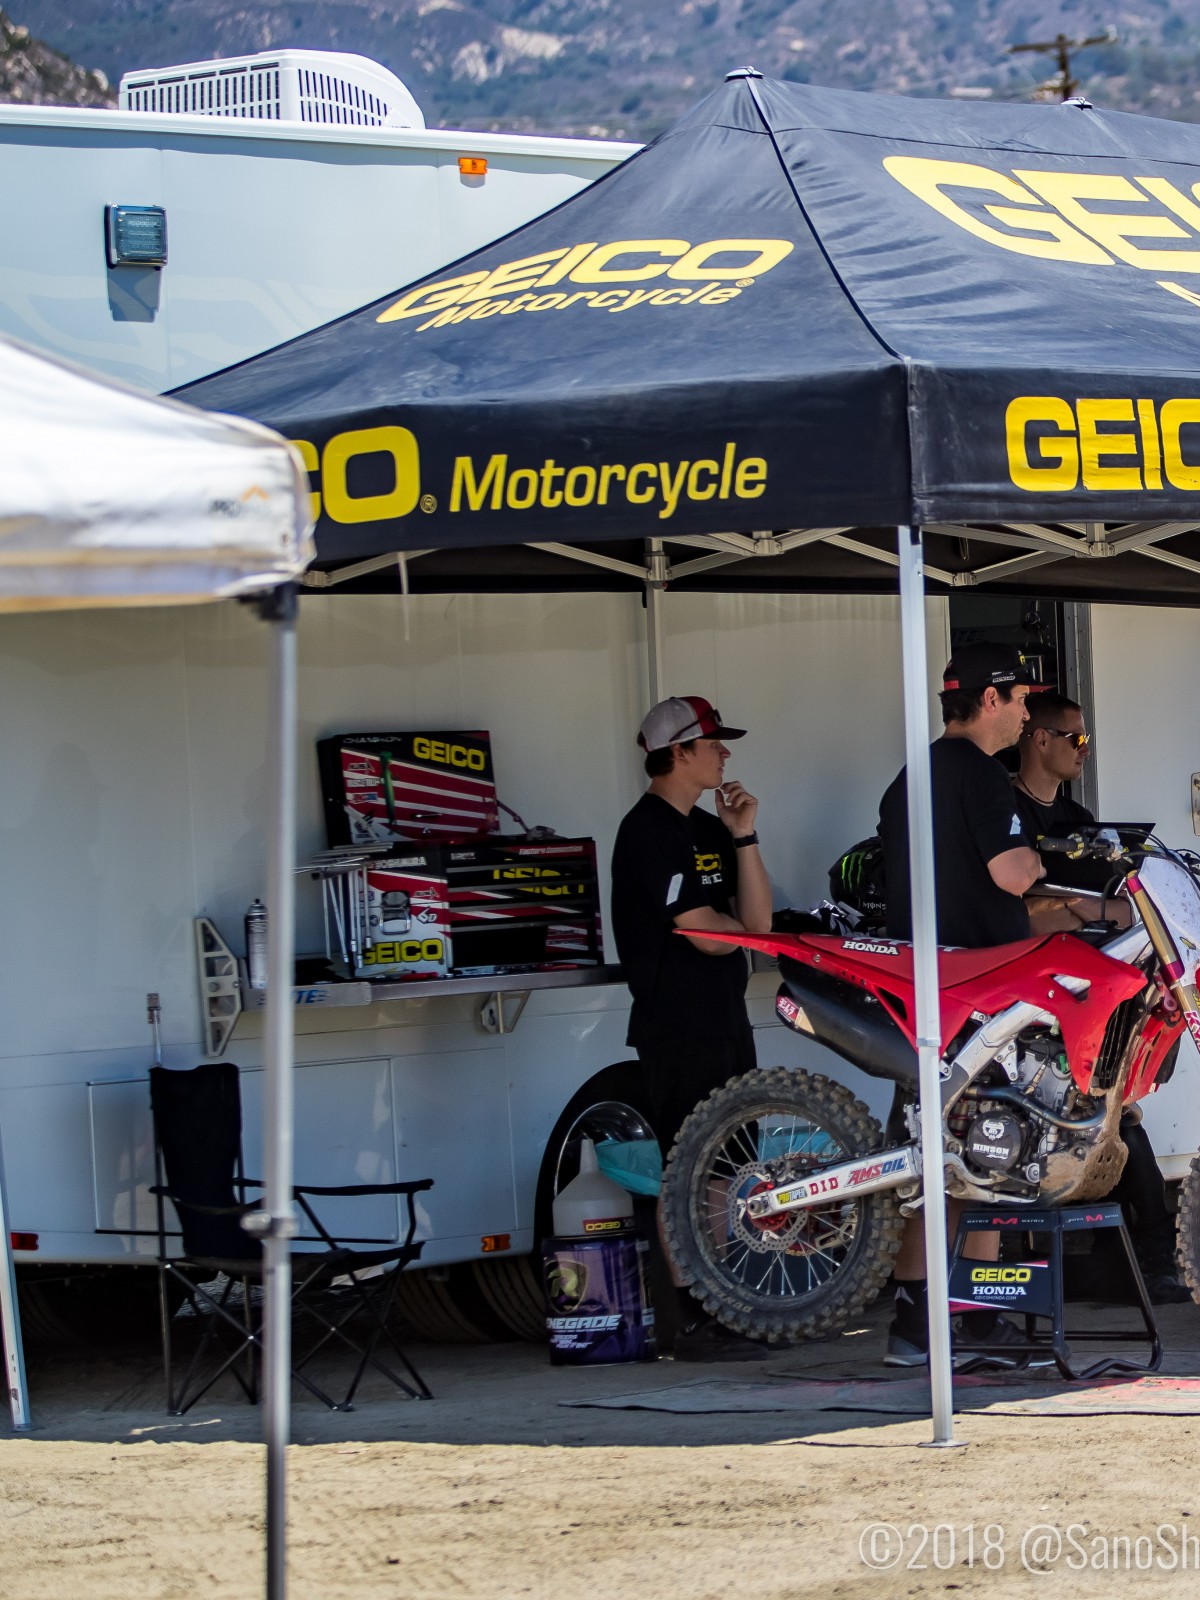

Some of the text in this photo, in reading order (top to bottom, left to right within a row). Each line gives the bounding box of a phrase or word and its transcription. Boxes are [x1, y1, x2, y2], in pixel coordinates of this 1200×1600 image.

[376, 239, 794, 323] GEICO
[416, 282, 743, 332] Motorcycle
[449, 442, 767, 519] Motorcycle
[412, 736, 486, 771] GEICO
[842, 940, 899, 956] HONDA
[846, 1156, 906, 1187] AMSOIL
[970, 1267, 1032, 1284] GEICO
[972, 1286, 1027, 1296] HONDA
[546, 1314, 624, 1329] NEGADE
